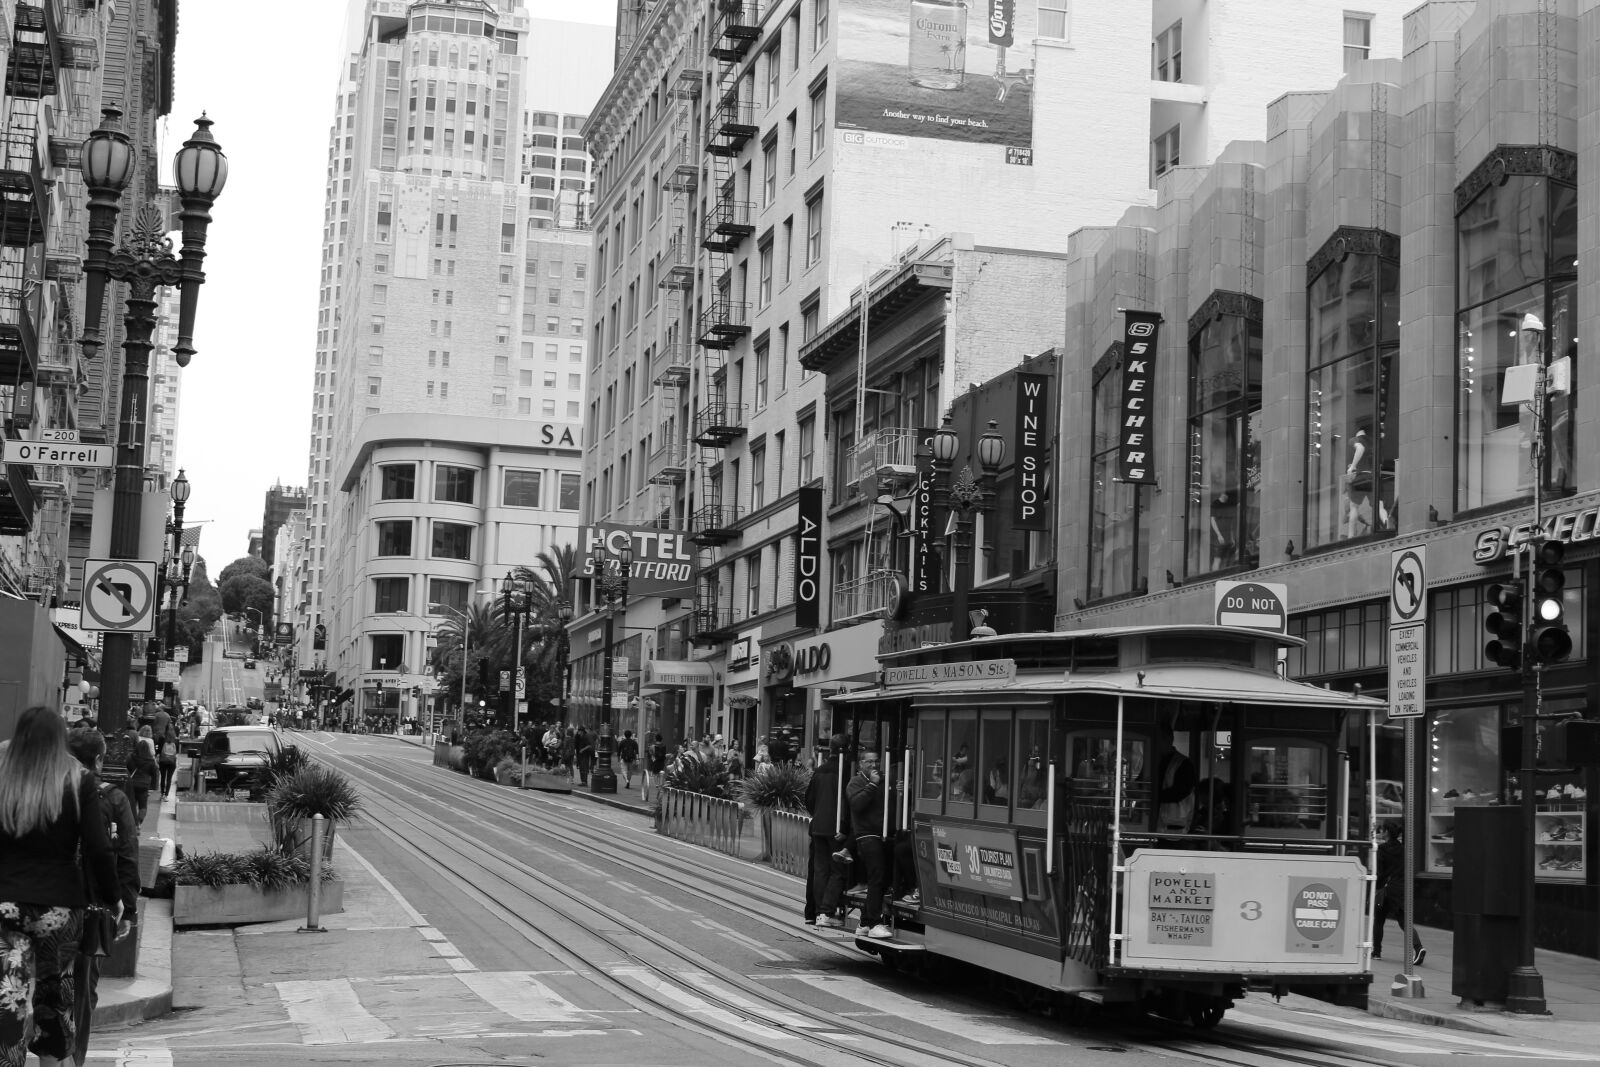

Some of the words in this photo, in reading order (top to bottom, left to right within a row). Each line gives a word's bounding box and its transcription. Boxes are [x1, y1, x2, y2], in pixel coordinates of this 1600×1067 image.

[915, 17, 958, 33] Corona
[926, 31, 951, 41] Extra
[882, 108, 911, 120] Another
[912, 113, 926, 123] way
[935, 113, 949, 124] find
[950, 117, 966, 127] your
[967, 117, 989, 128] beach.
[845, 133, 865, 144] BIG
[1023, 381, 1040, 446] WINE
[1125, 342, 1149, 478] SKECHERS
[54, 431, 75, 441] 200
[541, 424, 583, 447] SA
[20, 446, 98, 462] O'Farrell
[1021, 456, 1038, 520] SHOP
[919, 480, 931, 591] COCKTAILS
[586, 528, 691, 561] HOTEL
[800, 515, 817, 601] ALDO
[1227, 597, 1244, 609] DO
[1252, 598, 1276, 610] NOT
[794, 643, 831, 676] ALDO
[1397, 653, 1417, 664] VEHICLES
[889, 668, 928, 682] POWELL
[932, 668, 940, 679] &
[943, 664, 984, 678] MASON
[1403, 666, 1411, 676] AND
[1397, 678, 1417, 689] VEHICLES
[920, 840, 928, 858] 3
[979, 849, 999, 864] TOURIST
[999, 852, 1013, 867] PLAN
[1154, 878, 1212, 889] POWELL
[1168, 888, 1198, 896] AND
[1302, 891, 1316, 900] DO
[1316, 891, 1334, 900] NOT
[1152, 895, 1213, 905] MARKET
[1307, 900, 1329, 908] PASS
[934, 896, 947, 909] SAN
[947, 899, 980, 917] FRANCISCO
[980, 907, 1013, 925] MUNICIPAL
[1239, 900, 1263, 921] 3
[1151, 912, 1167, 923] BAY
[1180, 913, 1212, 925] TAYLOR
[1296, 920, 1320, 928] CABLE
[1321, 921, 1337, 929] CAR
[1156, 924, 1205, 934] FISHERMANS
[1168, 932, 1193, 941] WHARF
